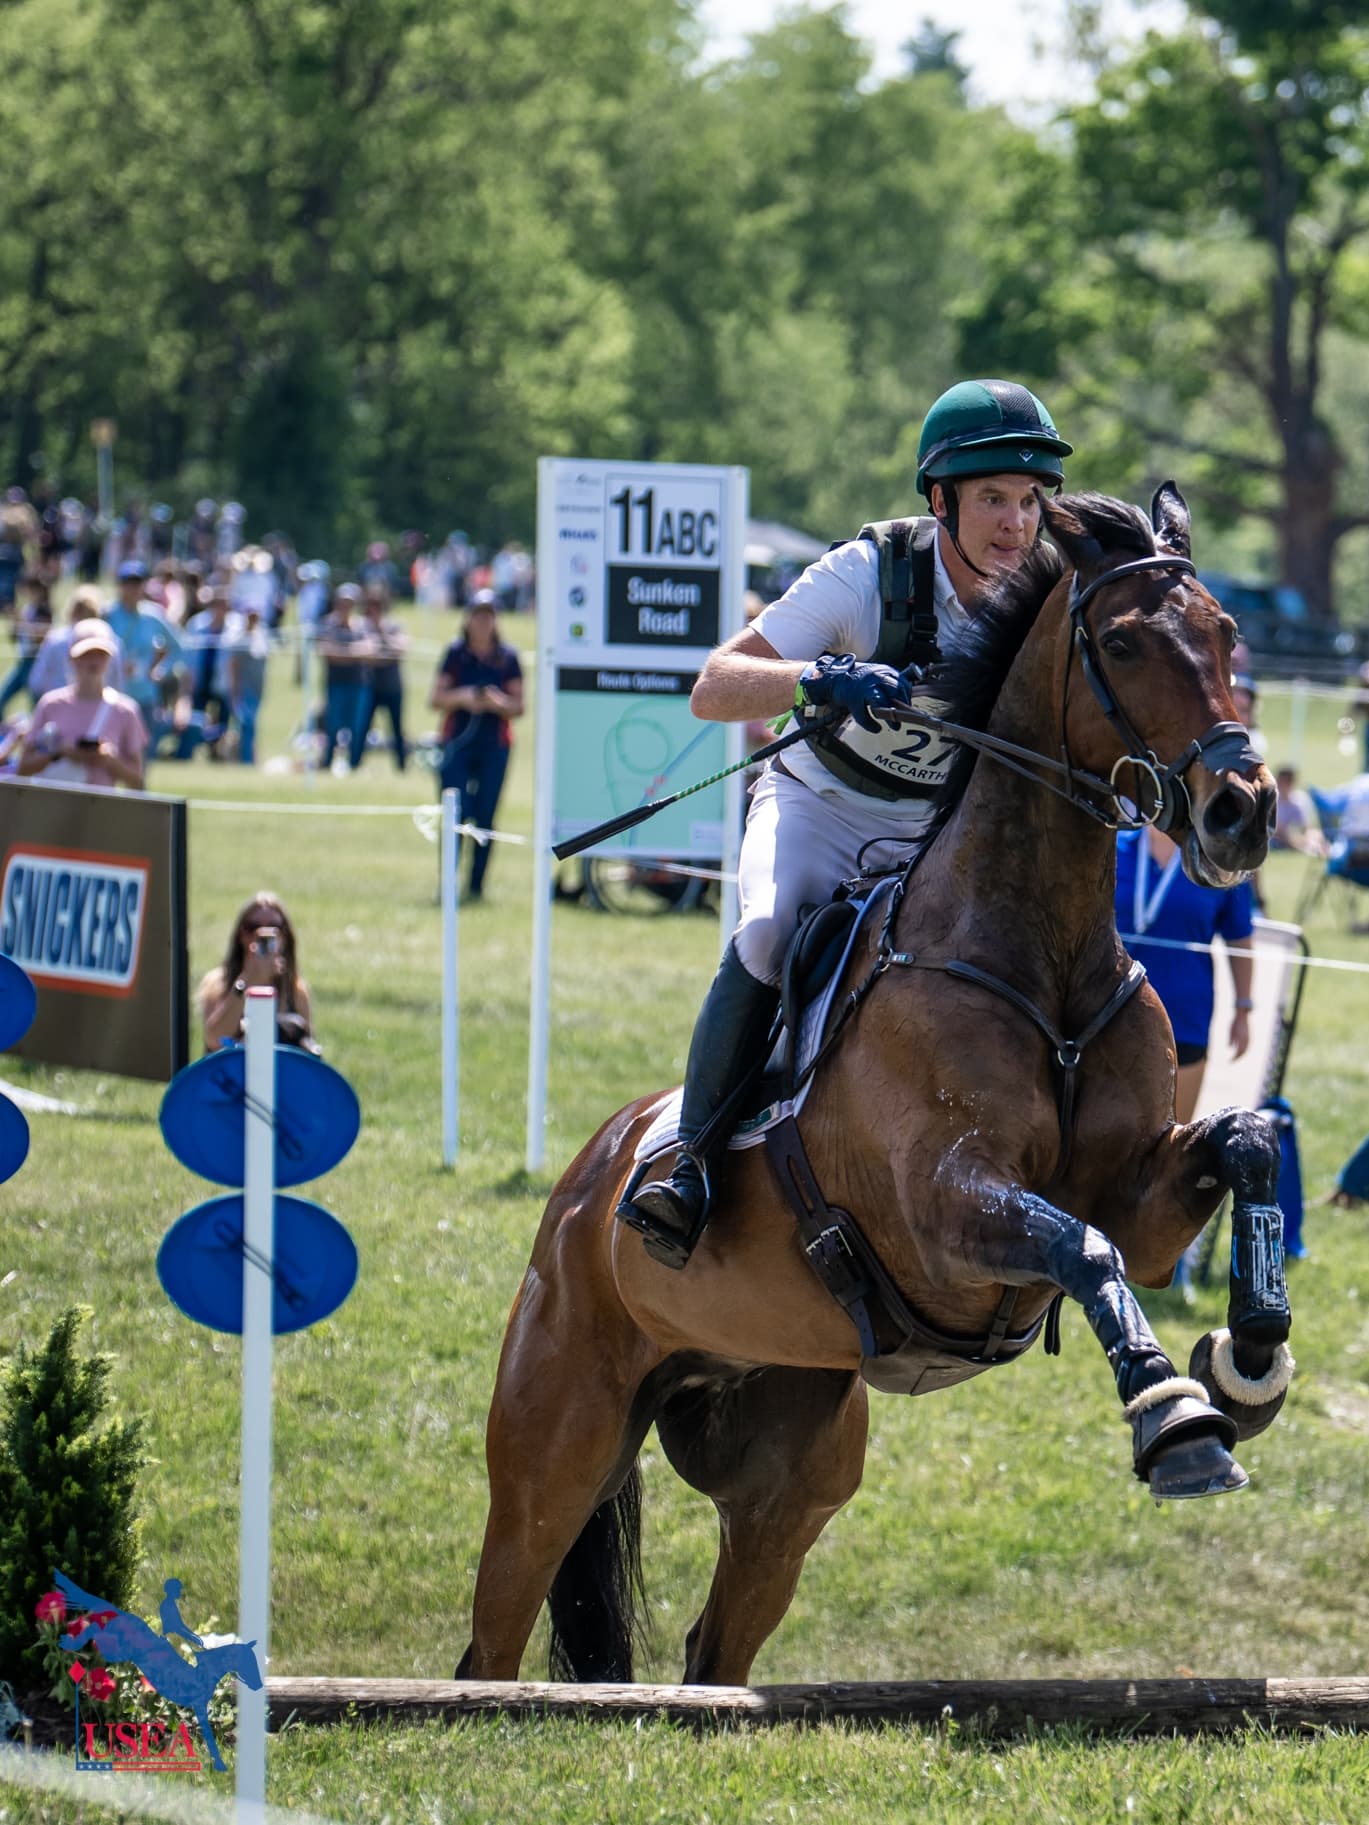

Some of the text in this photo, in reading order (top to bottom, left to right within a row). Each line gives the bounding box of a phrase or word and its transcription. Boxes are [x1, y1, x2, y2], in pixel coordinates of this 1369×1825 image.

[627, 576, 700, 606] Sunken
[638, 607, 690, 636] Road
[891, 730, 961, 767] 27
[3, 865, 139, 975] SNICKERS
